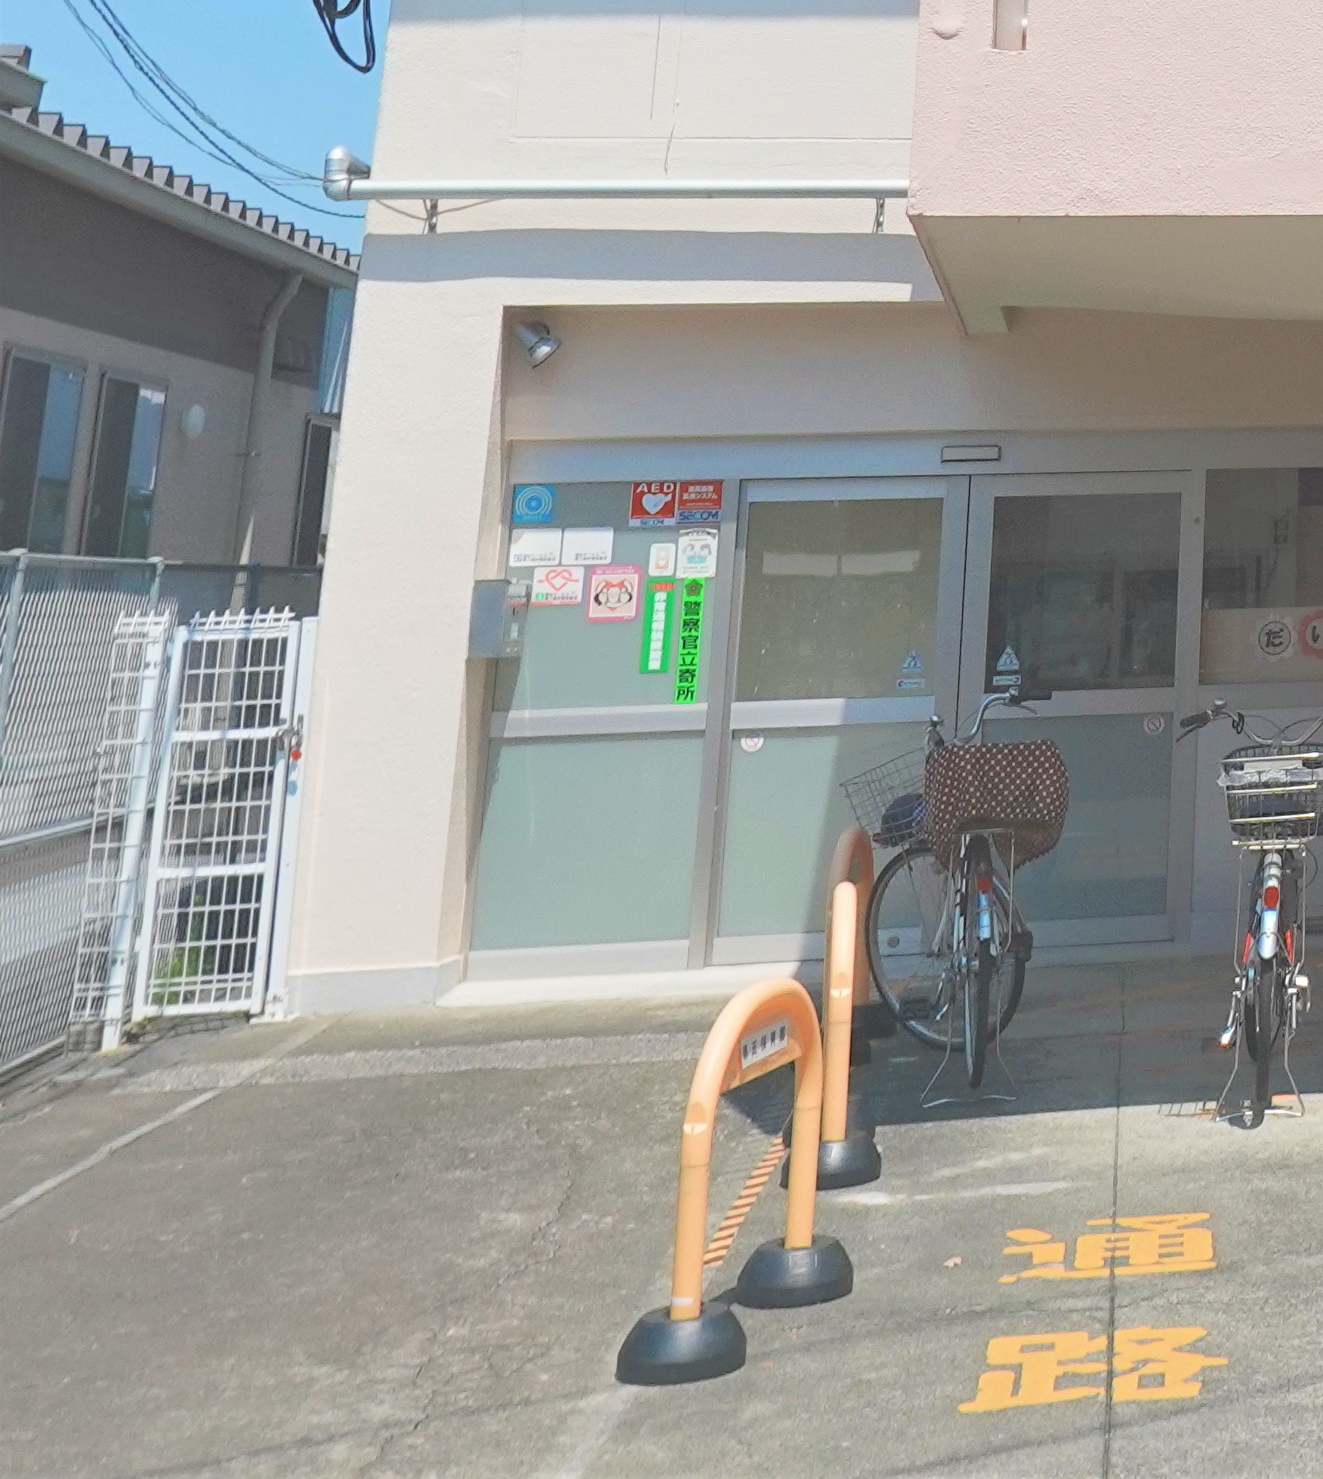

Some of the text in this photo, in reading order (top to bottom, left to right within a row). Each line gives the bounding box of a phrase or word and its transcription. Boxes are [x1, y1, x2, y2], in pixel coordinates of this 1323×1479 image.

[636, 482, 675, 494] AED
[676, 601, 701, 702] 警察官立寄所
